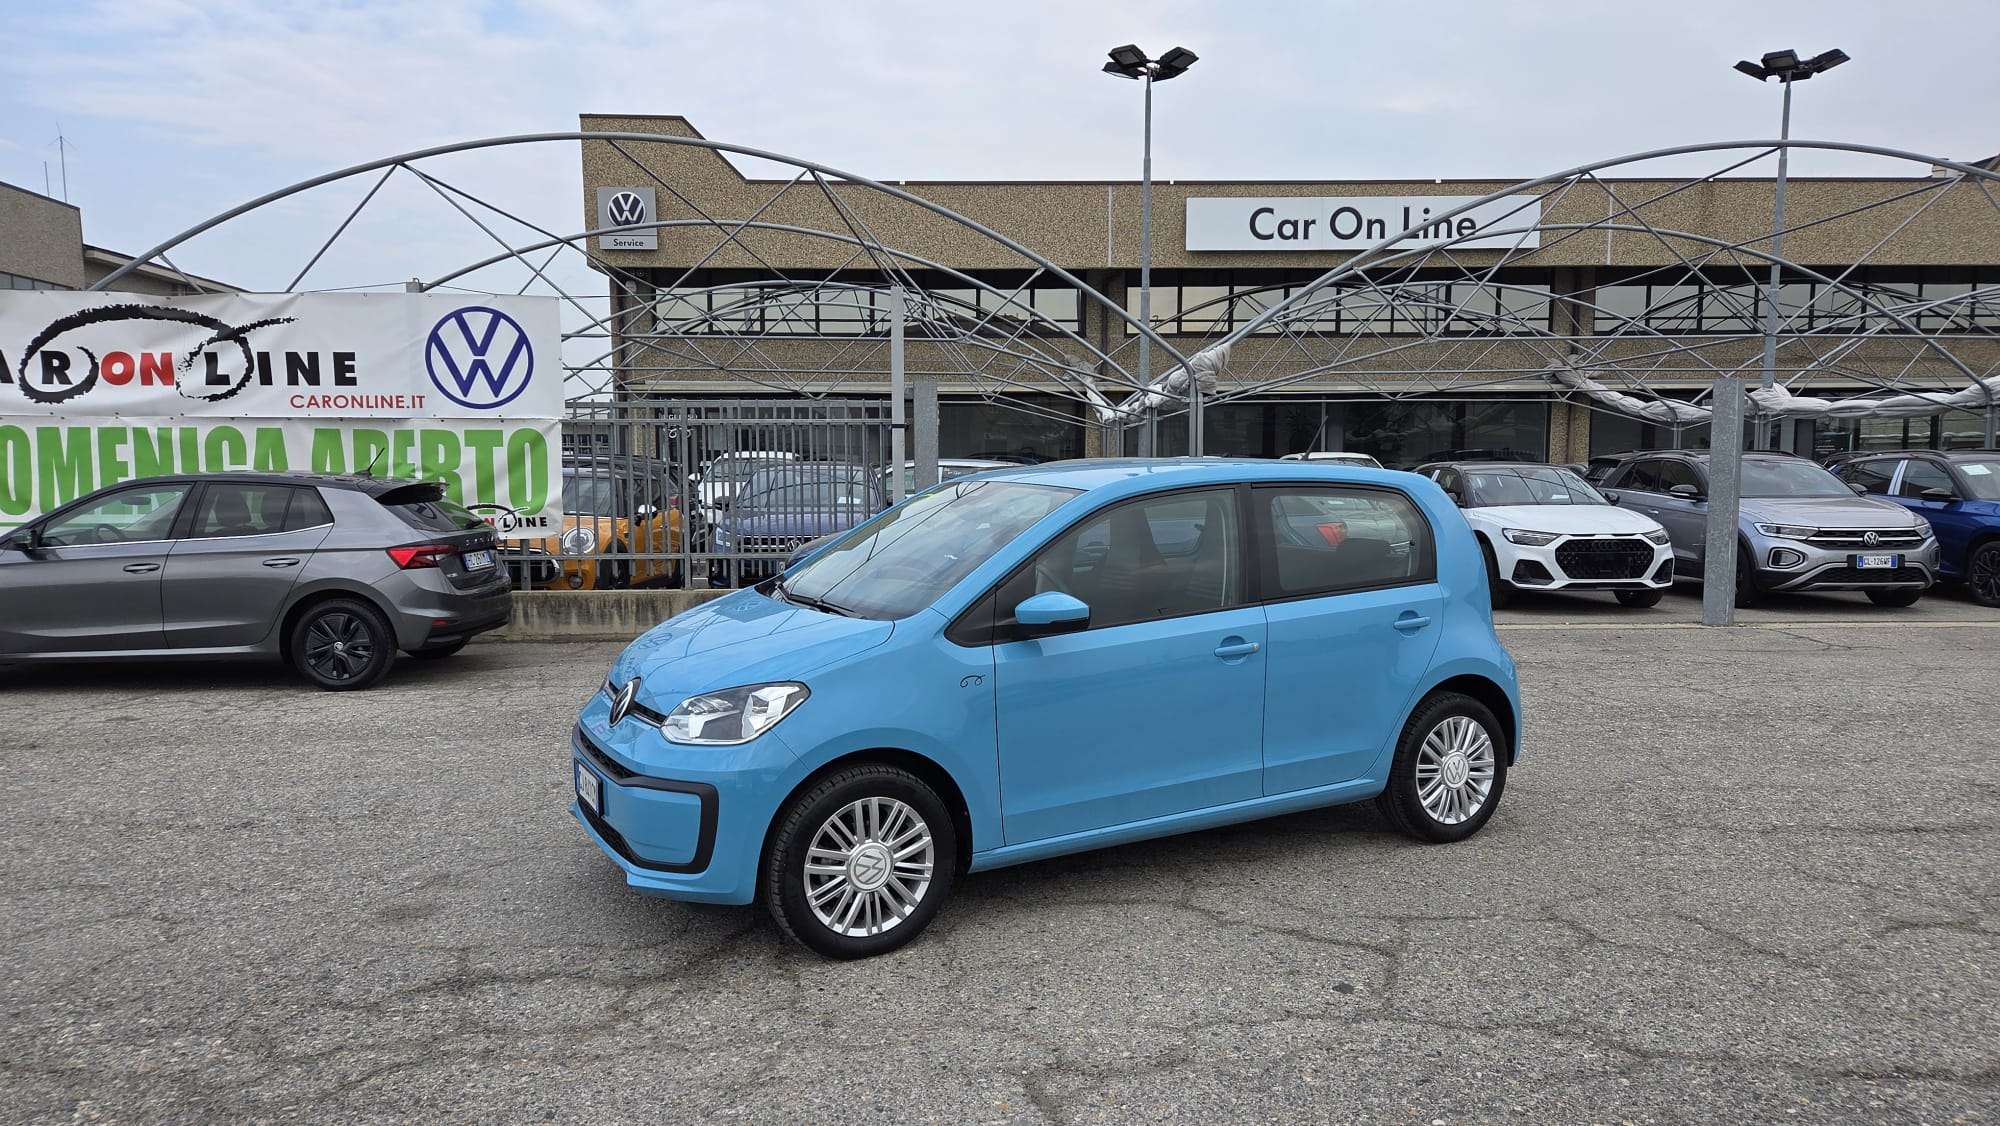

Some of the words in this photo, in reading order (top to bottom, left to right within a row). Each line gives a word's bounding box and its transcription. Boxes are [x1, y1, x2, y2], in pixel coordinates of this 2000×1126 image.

[1249, 207, 1316, 241] Car
[1329, 206, 1387, 241] On
[1403, 206, 1477, 240] Line
[613, 238, 644, 247] Service
[290, 394, 426, 409] CARONLINE.IT
